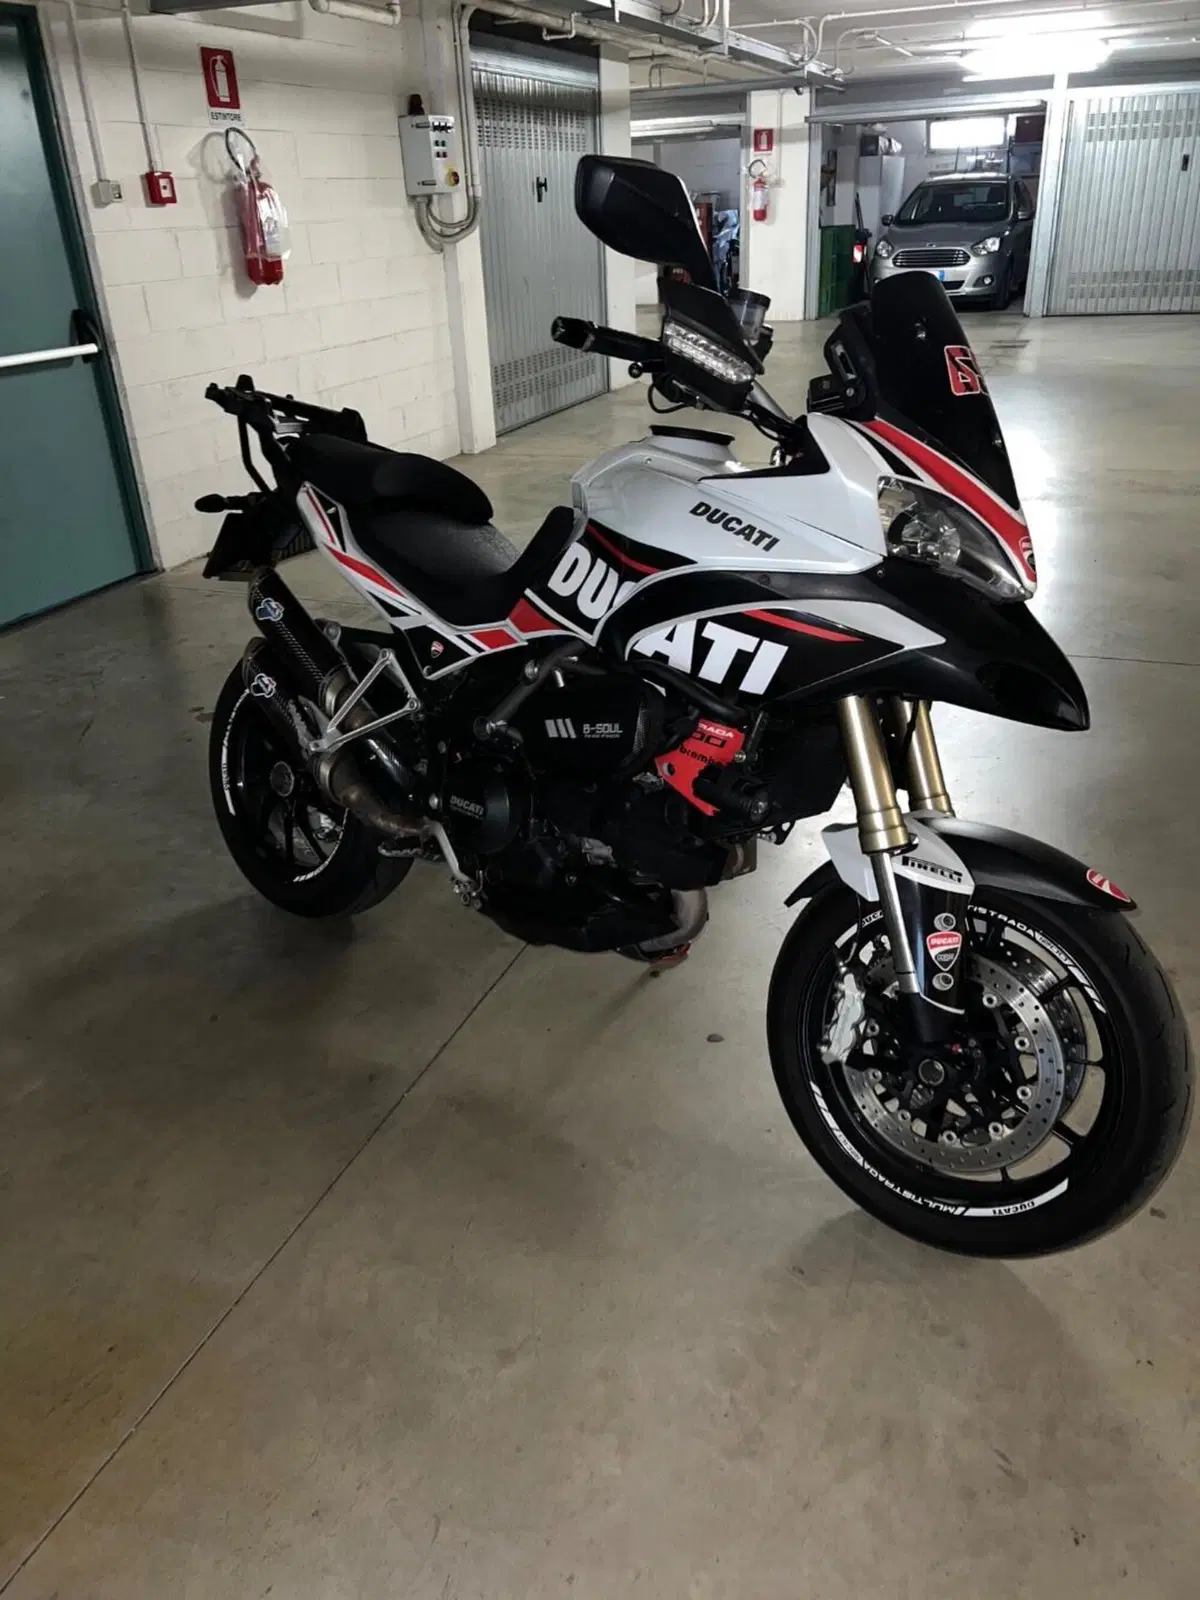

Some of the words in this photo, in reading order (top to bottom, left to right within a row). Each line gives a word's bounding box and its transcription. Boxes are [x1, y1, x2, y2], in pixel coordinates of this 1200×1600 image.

[689, 501, 780, 552] DUCATI
[450, 795, 484, 815] DUCATI
[902, 855, 962, 882] PIRELLI
[930, 937, 959, 946] DUCATI
[992, 1200, 1035, 1215] DUCATI
